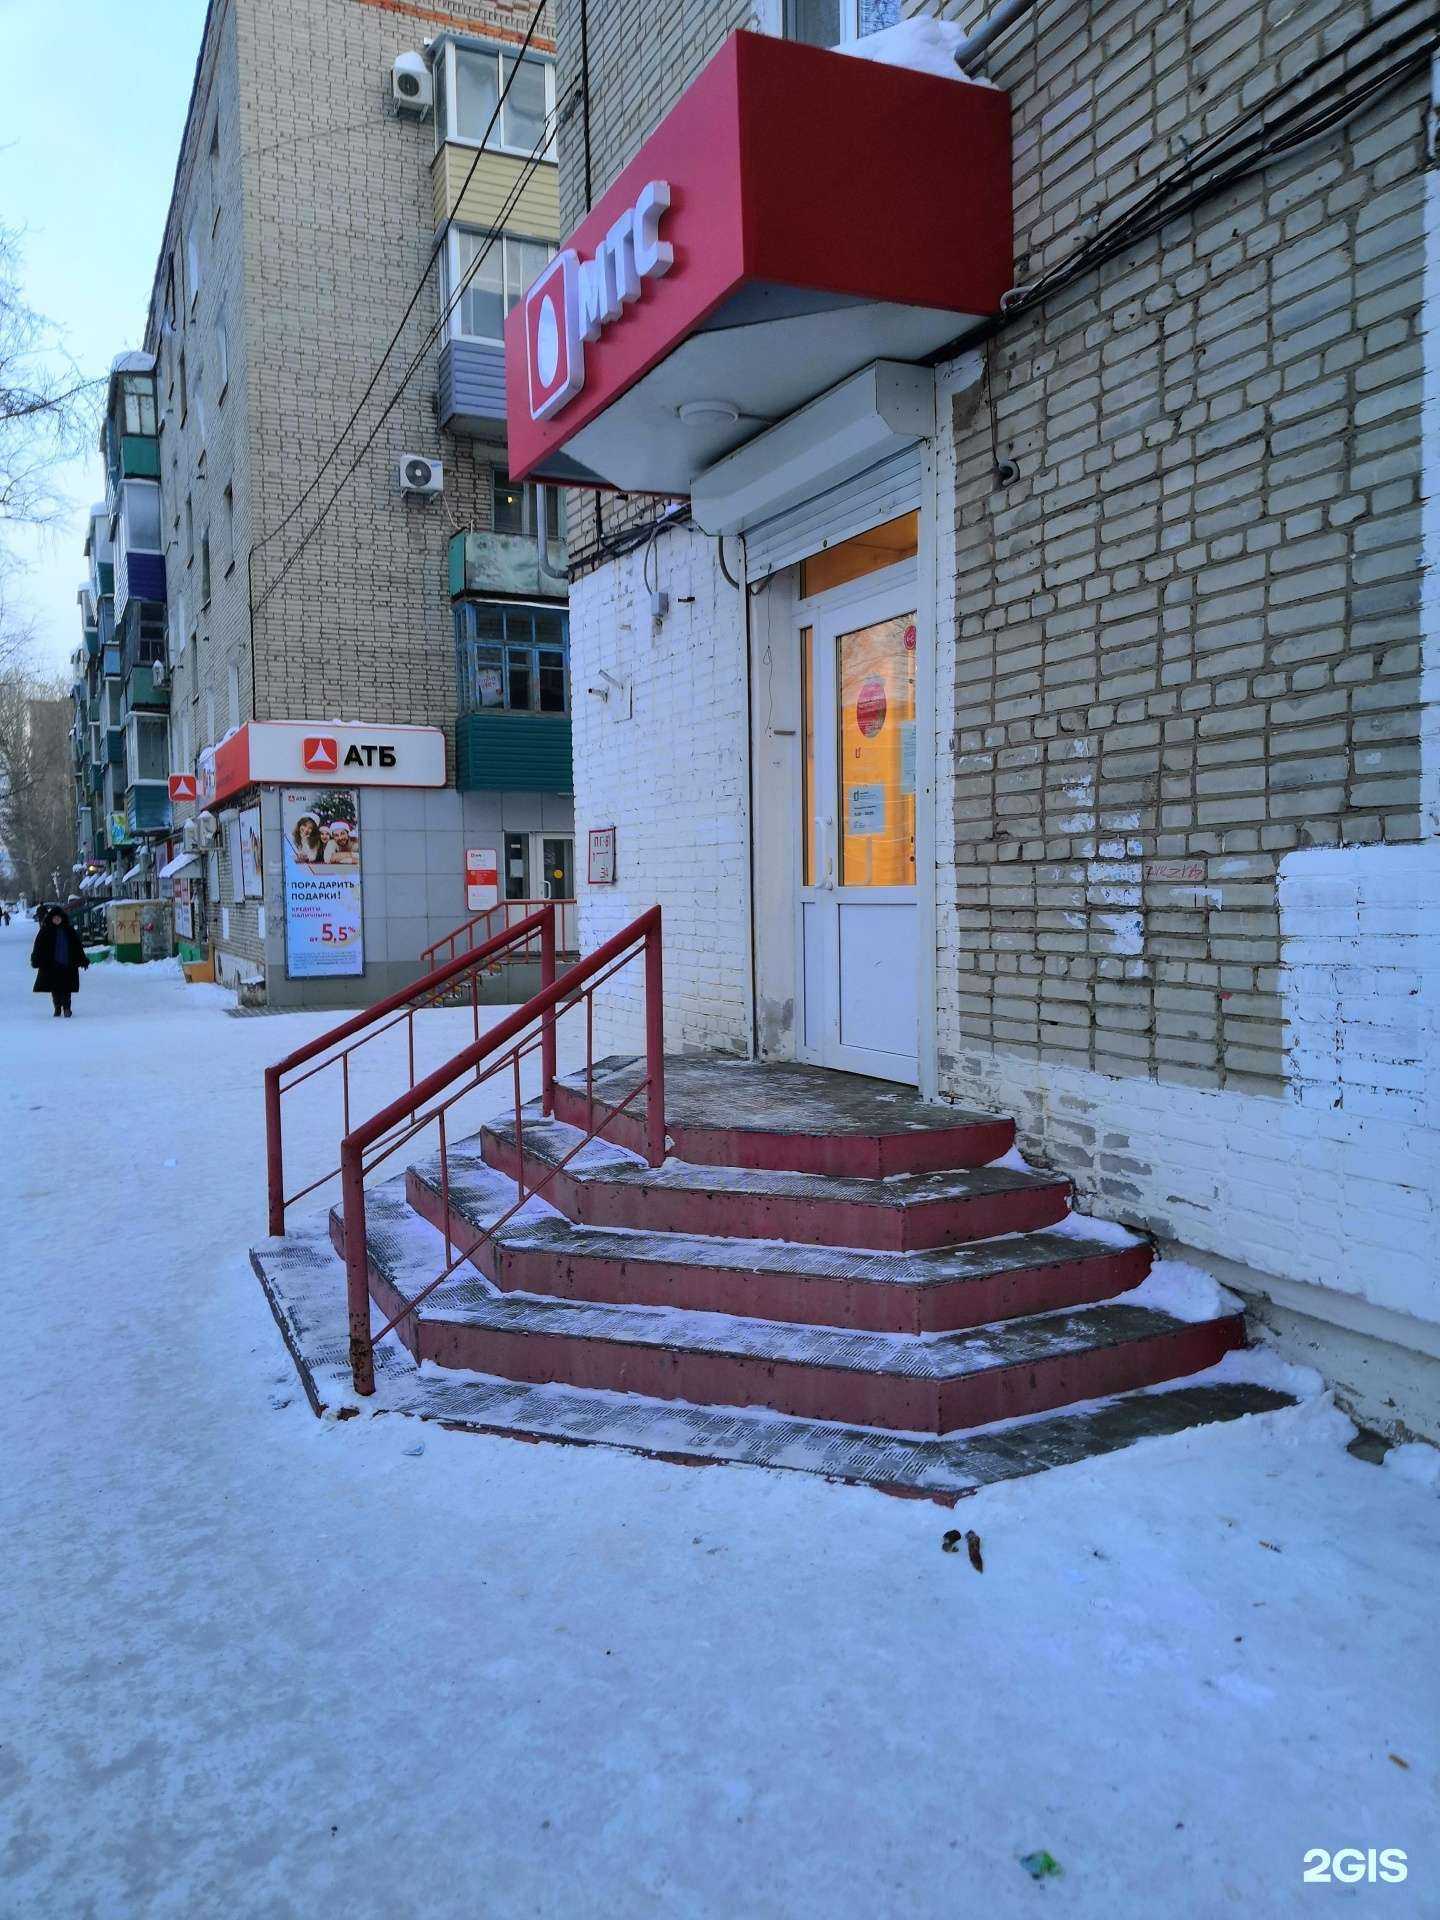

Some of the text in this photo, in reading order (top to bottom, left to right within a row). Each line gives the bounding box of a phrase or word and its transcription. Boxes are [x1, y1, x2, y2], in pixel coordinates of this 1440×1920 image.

[578, 180, 674, 342] МТС
[343, 744, 397, 768] АТБ
[291, 881, 354, 889] ПОРА ДАРИТЬ
[291, 891, 341, 900] ПОДАРКИ!
